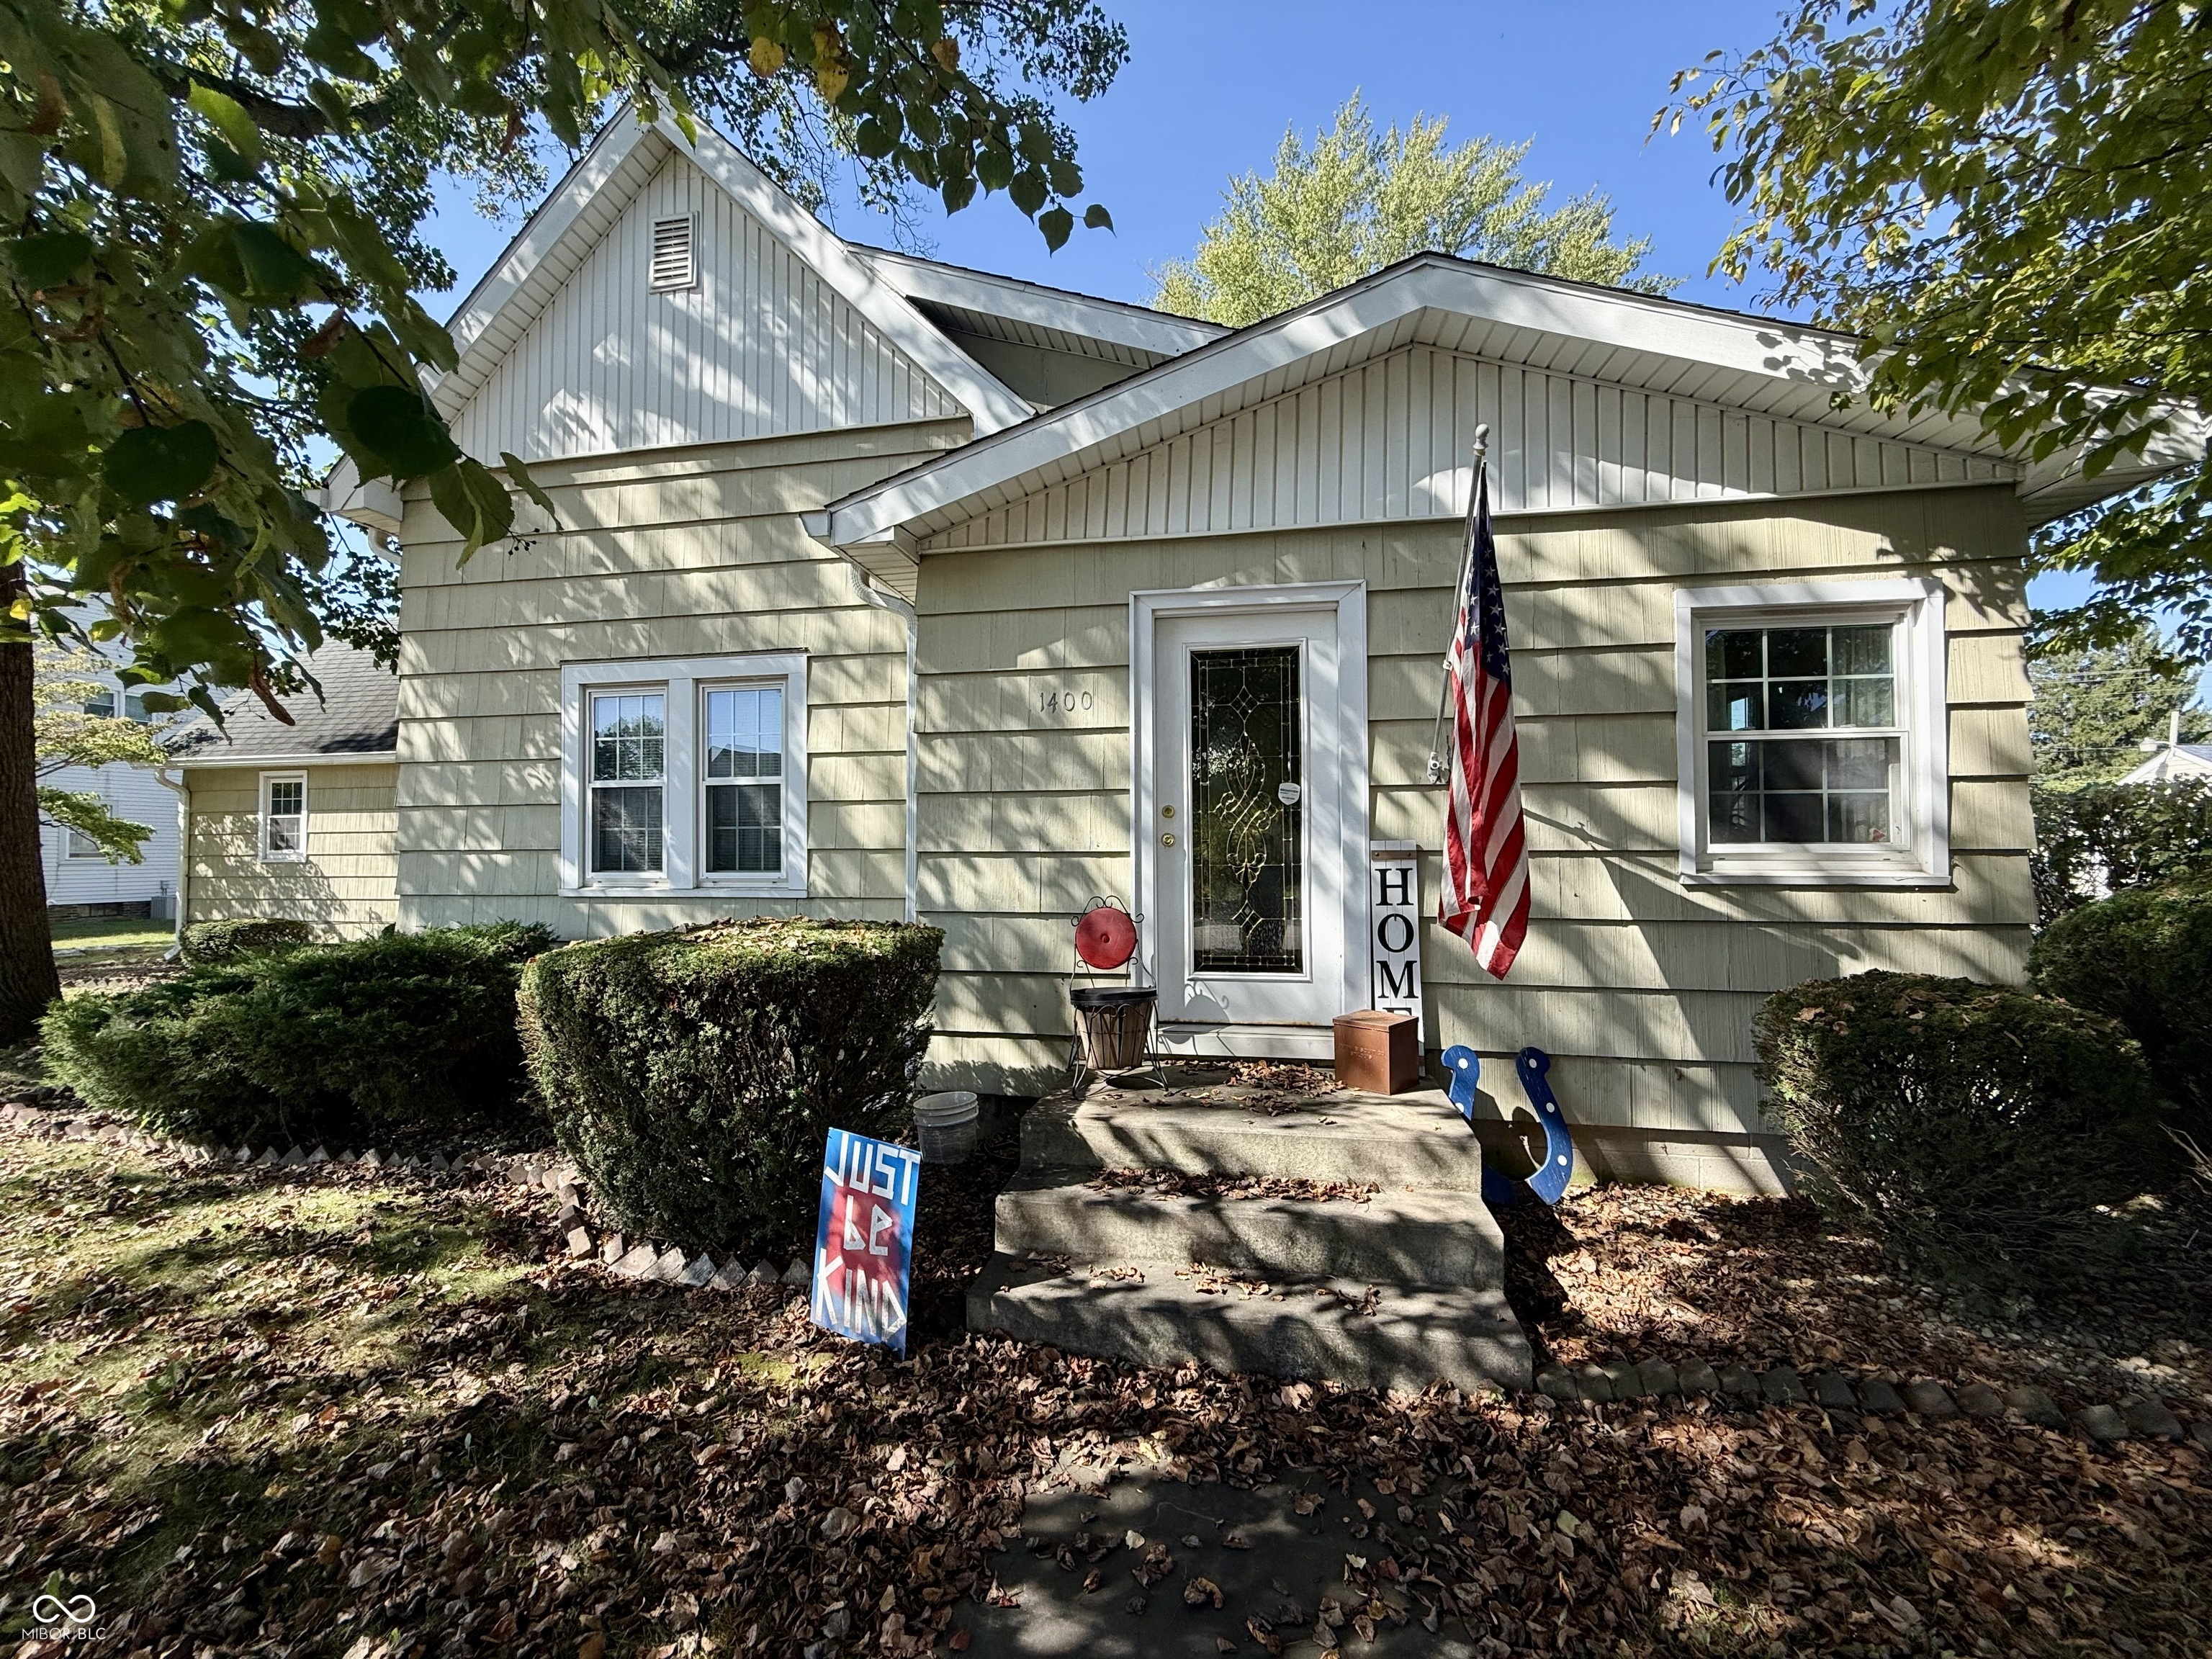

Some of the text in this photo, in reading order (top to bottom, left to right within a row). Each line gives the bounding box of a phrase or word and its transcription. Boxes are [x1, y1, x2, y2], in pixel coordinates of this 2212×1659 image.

[1040, 691, 1092, 714] 1400
[1375, 868, 1419, 1015] HOM
[824, 1133, 921, 1205] JUST
[815, 1247, 907, 1341] KIND
